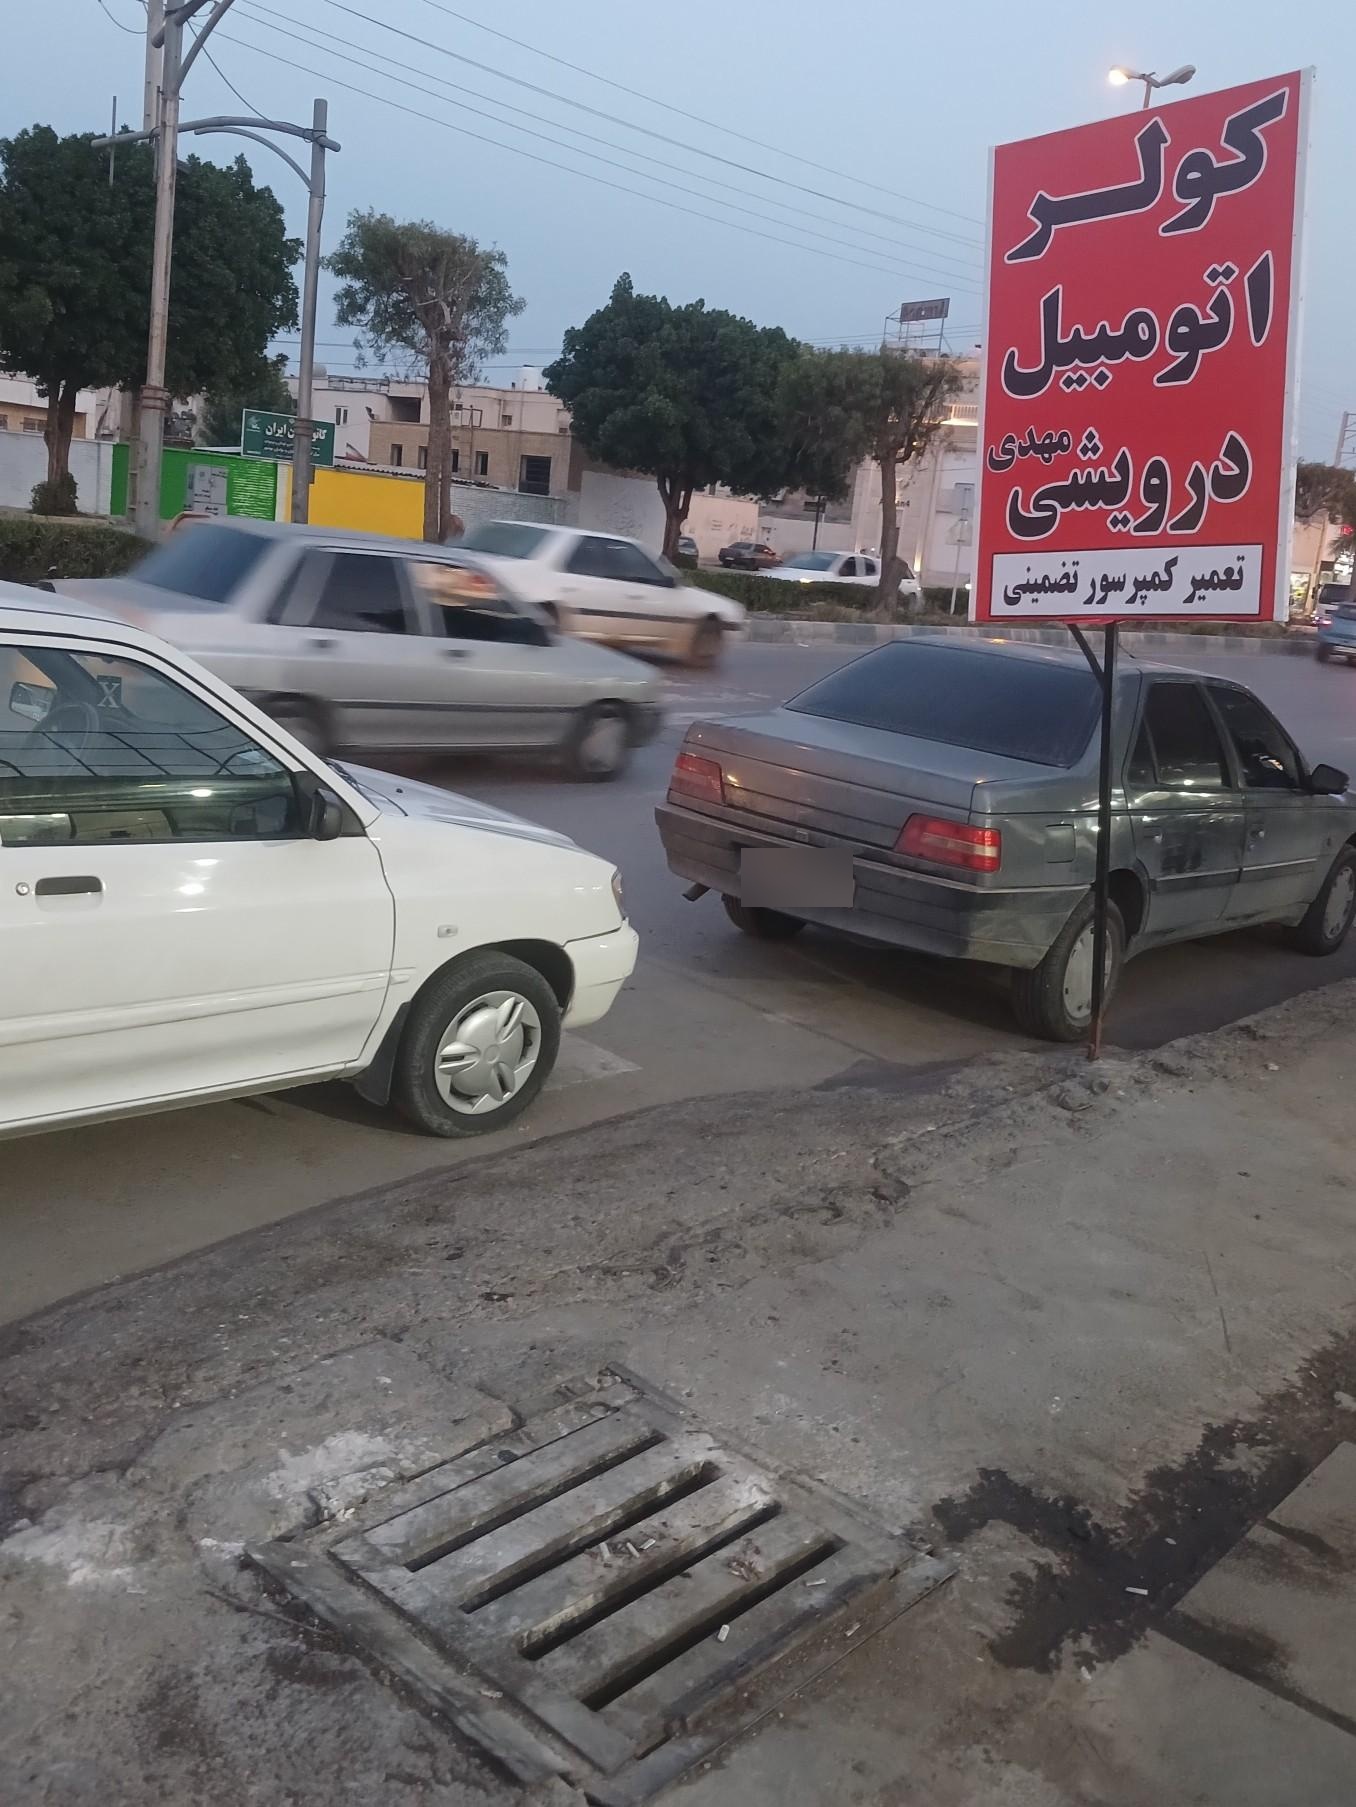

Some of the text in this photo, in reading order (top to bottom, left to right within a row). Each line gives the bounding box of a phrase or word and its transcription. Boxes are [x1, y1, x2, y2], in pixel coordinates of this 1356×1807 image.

[1004, 87, 1290, 265] کولر
[1000, 249, 1275, 400] اتومبیل
[265, 422, 287, 438] ایران
[987, 423, 1072, 473] مهدی
[1005, 426, 1254, 541] درویشی
[1003, 554, 1245, 607] تعمیر کمپرسور تضمینی
